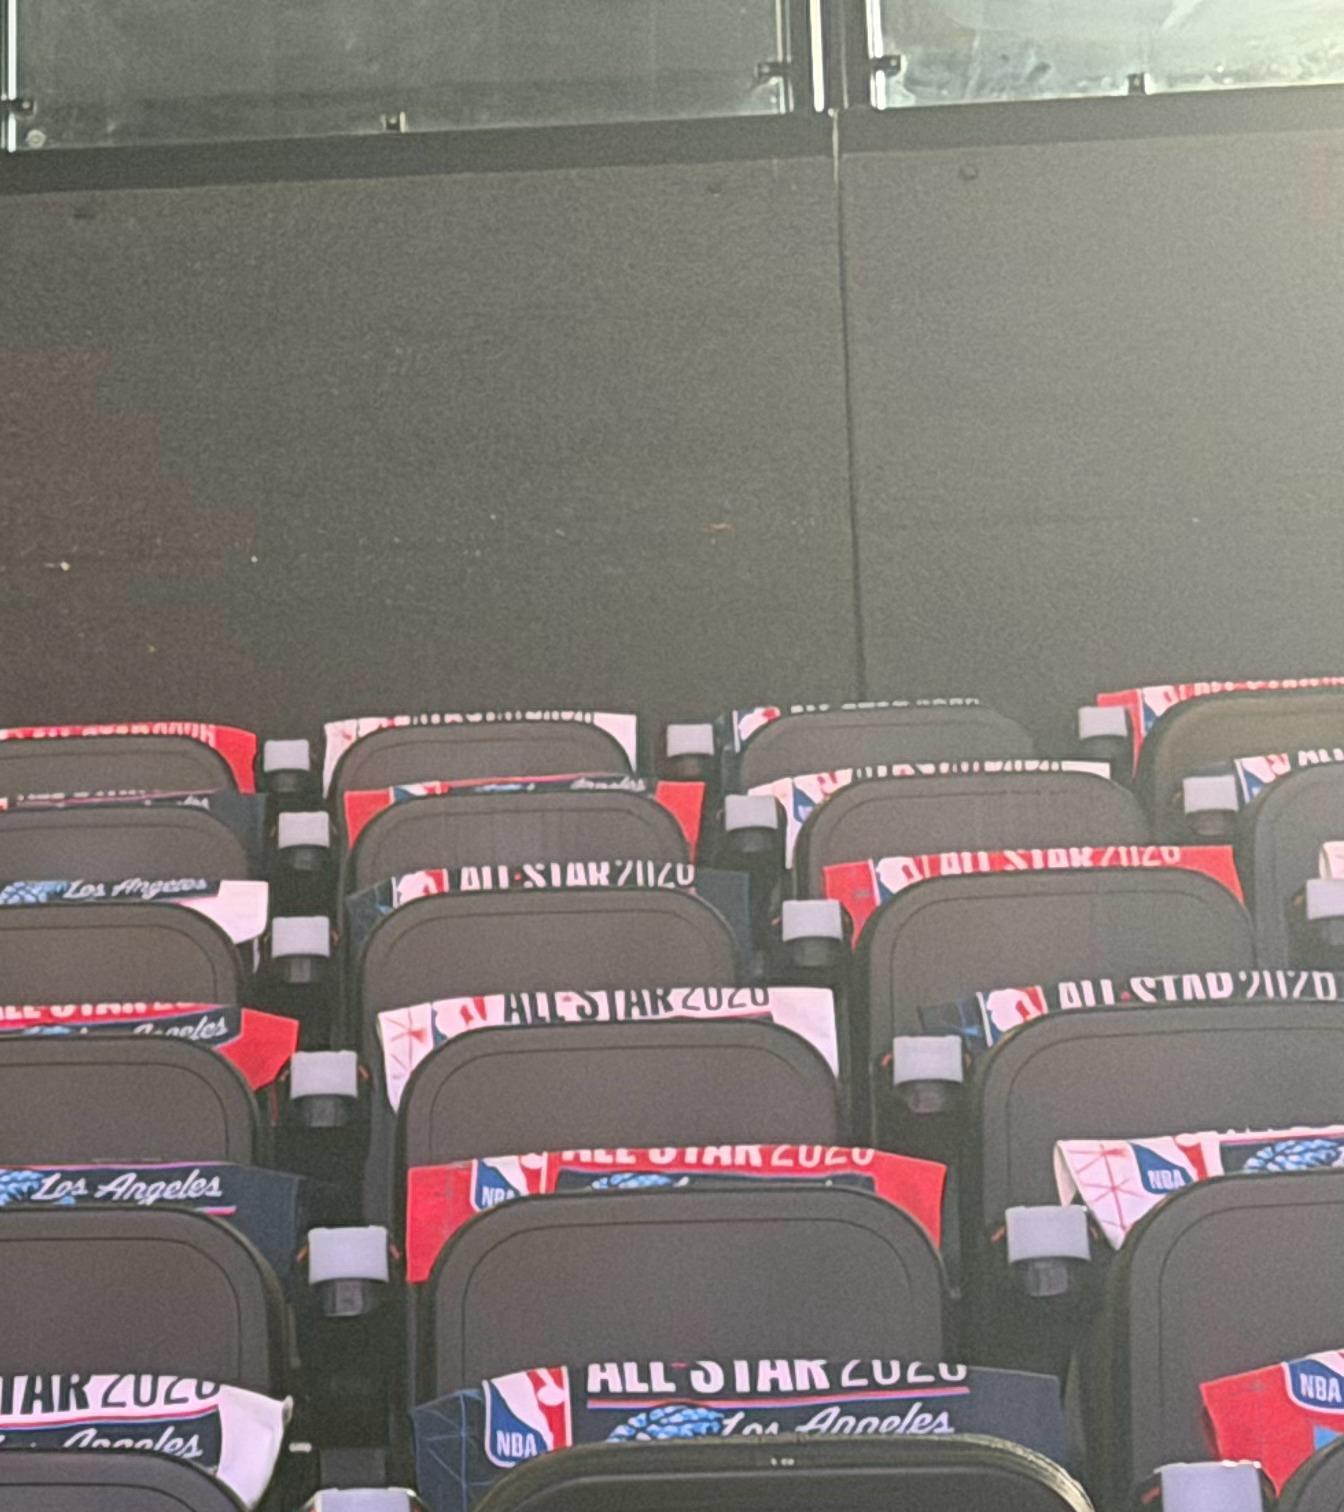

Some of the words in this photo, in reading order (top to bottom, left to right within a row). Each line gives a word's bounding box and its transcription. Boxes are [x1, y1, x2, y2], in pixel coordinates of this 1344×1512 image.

[31, 1172, 89, 1201] Los
[94, 1168, 223, 1206] Angeles
[1147, 1169, 1185, 1190] NBA
[1300, 1373, 1342, 1403] NBA
[495, 1431, 537, 1459] NBA
